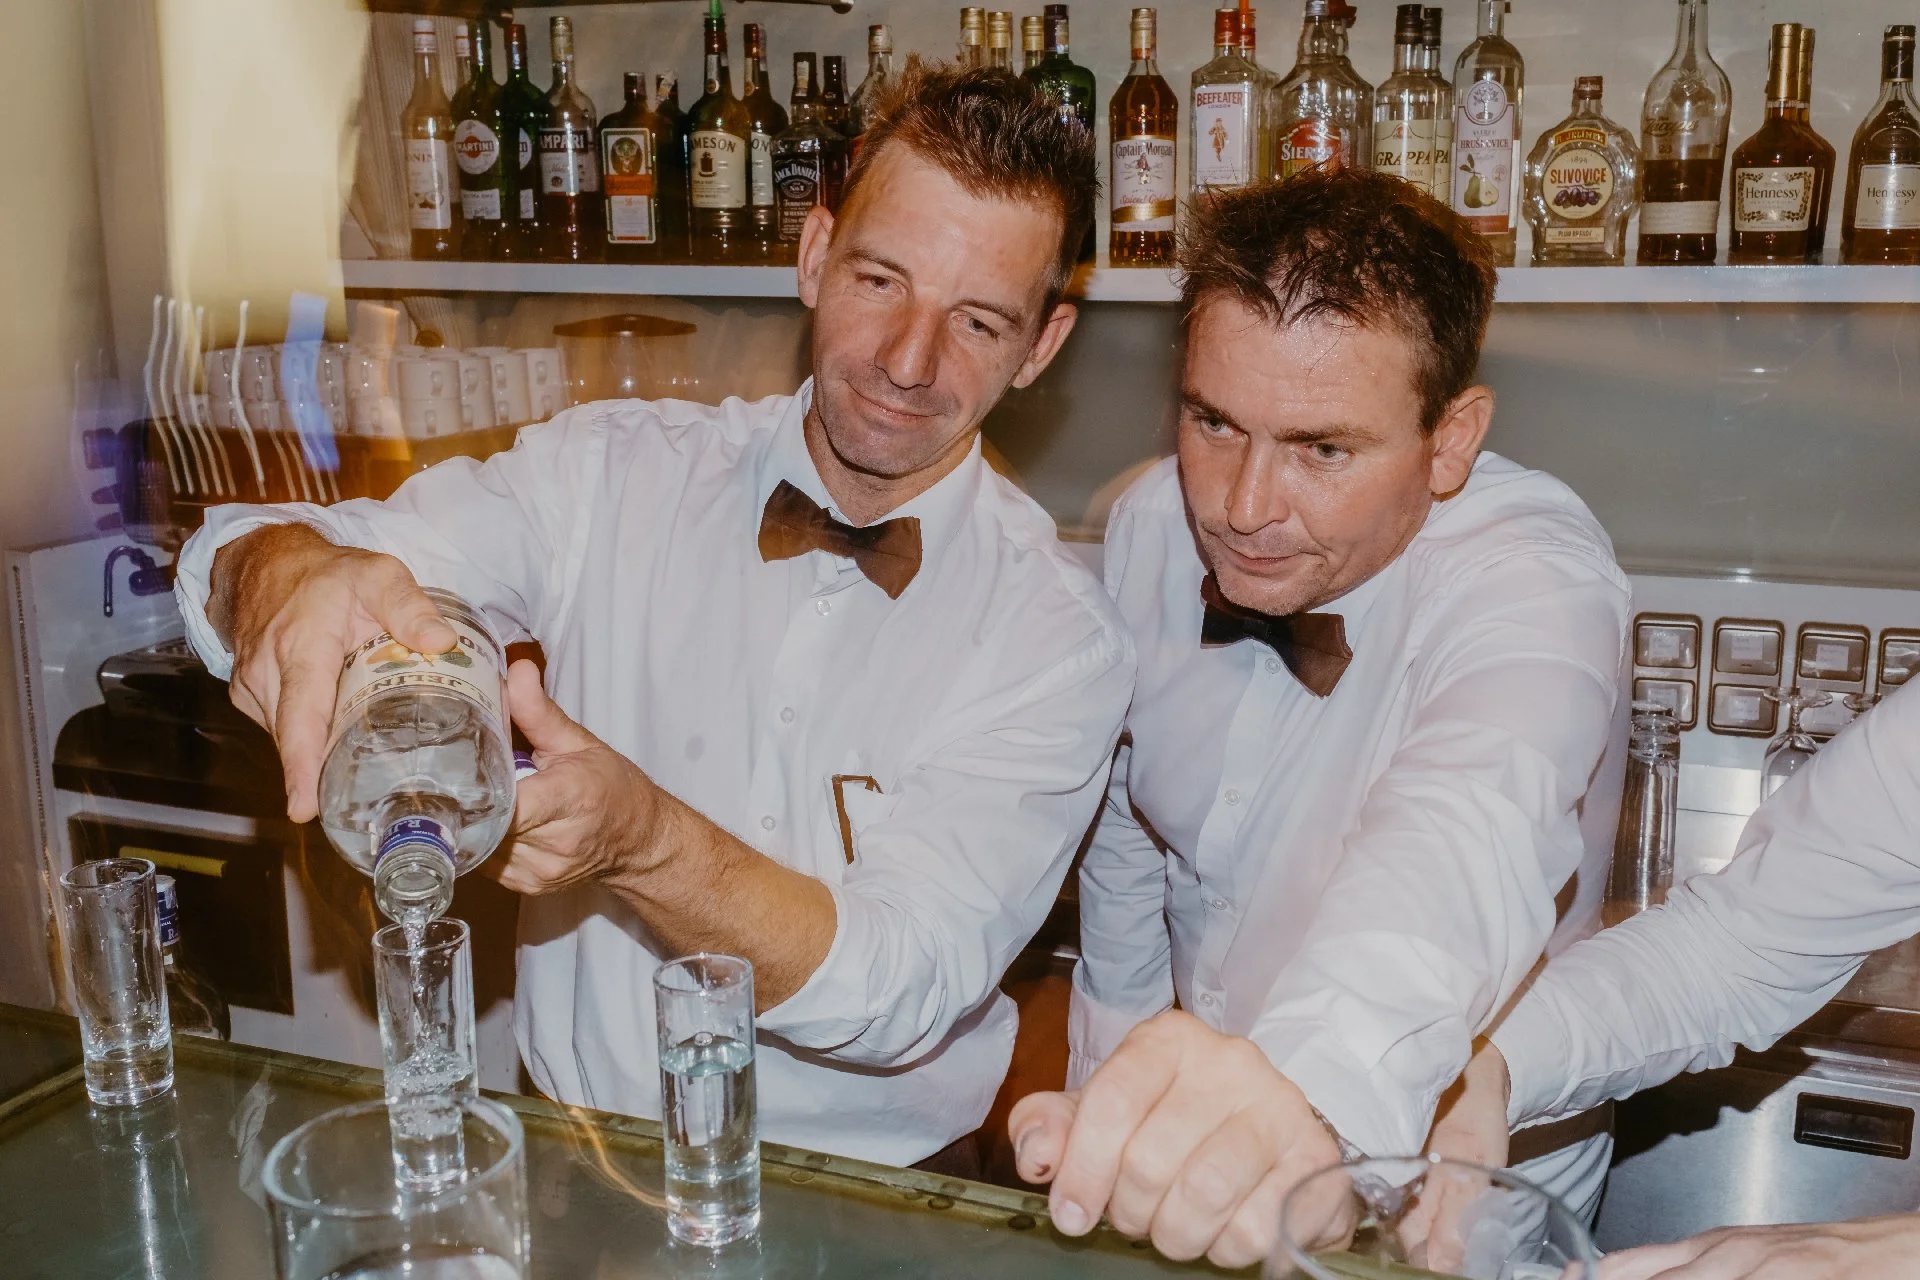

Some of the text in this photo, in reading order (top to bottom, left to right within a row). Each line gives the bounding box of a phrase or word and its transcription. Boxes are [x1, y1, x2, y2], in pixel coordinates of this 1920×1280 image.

[1197, 91, 1242, 107] BEEFEATER
[1116, 143, 1143, 158] Captain
[1376, 150, 1431, 166] GRAPPA
[775, 167, 792, 183] JACK
[1550, 167, 1607, 184] SLIVOVICE
[1746, 187, 1800, 201] Hennessy
